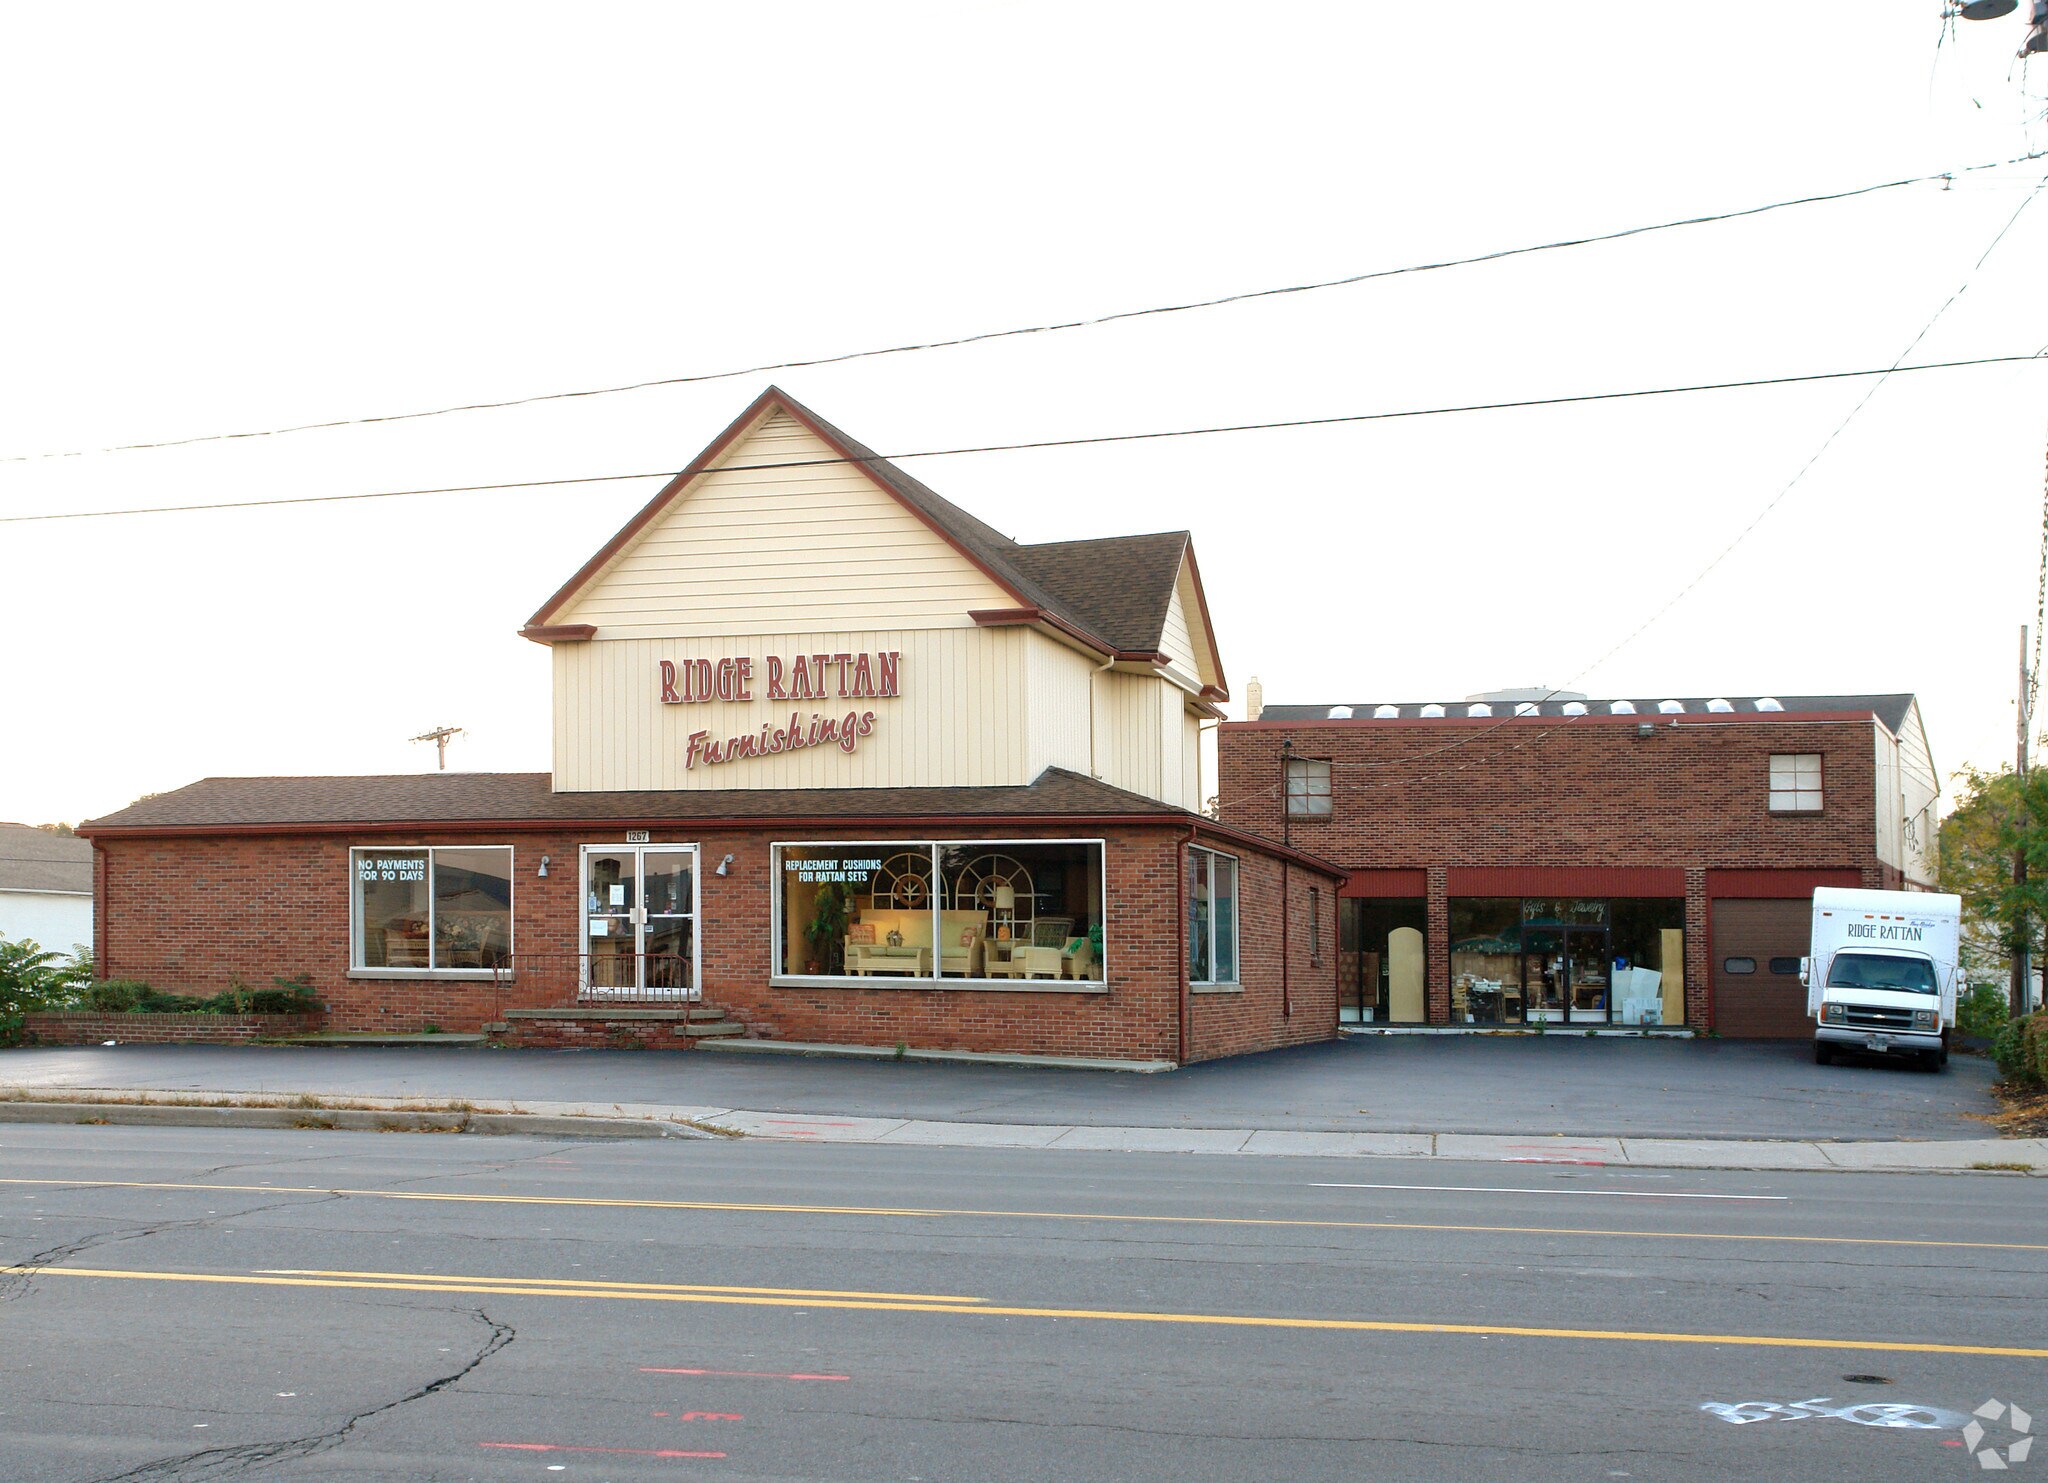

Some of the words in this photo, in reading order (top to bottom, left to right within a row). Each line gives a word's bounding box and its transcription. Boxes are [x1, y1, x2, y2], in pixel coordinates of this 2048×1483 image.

[659, 656, 753, 703] RIDGE
[766, 650, 902, 700] RATTAN
[685, 710, 878, 770] Furnishings
[627, 831, 648, 841] 1267
[358, 859, 374, 870] NO
[377, 859, 425, 870] PAYMENTS
[785, 860, 839, 871] REPLACEMENT
[842, 859, 882, 871] CUSHIONS
[359, 870, 378, 881] FOR
[381, 870, 396, 881] 90
[399, 870, 424, 881] DAYS
[798, 871, 814, 882] FOR
[815, 871, 846, 882] RATTAN
[847, 871, 868, 882] SETS
[1847, 923, 1877, 938] RIDGE
[1879, 925, 1922, 941] RATTAN
